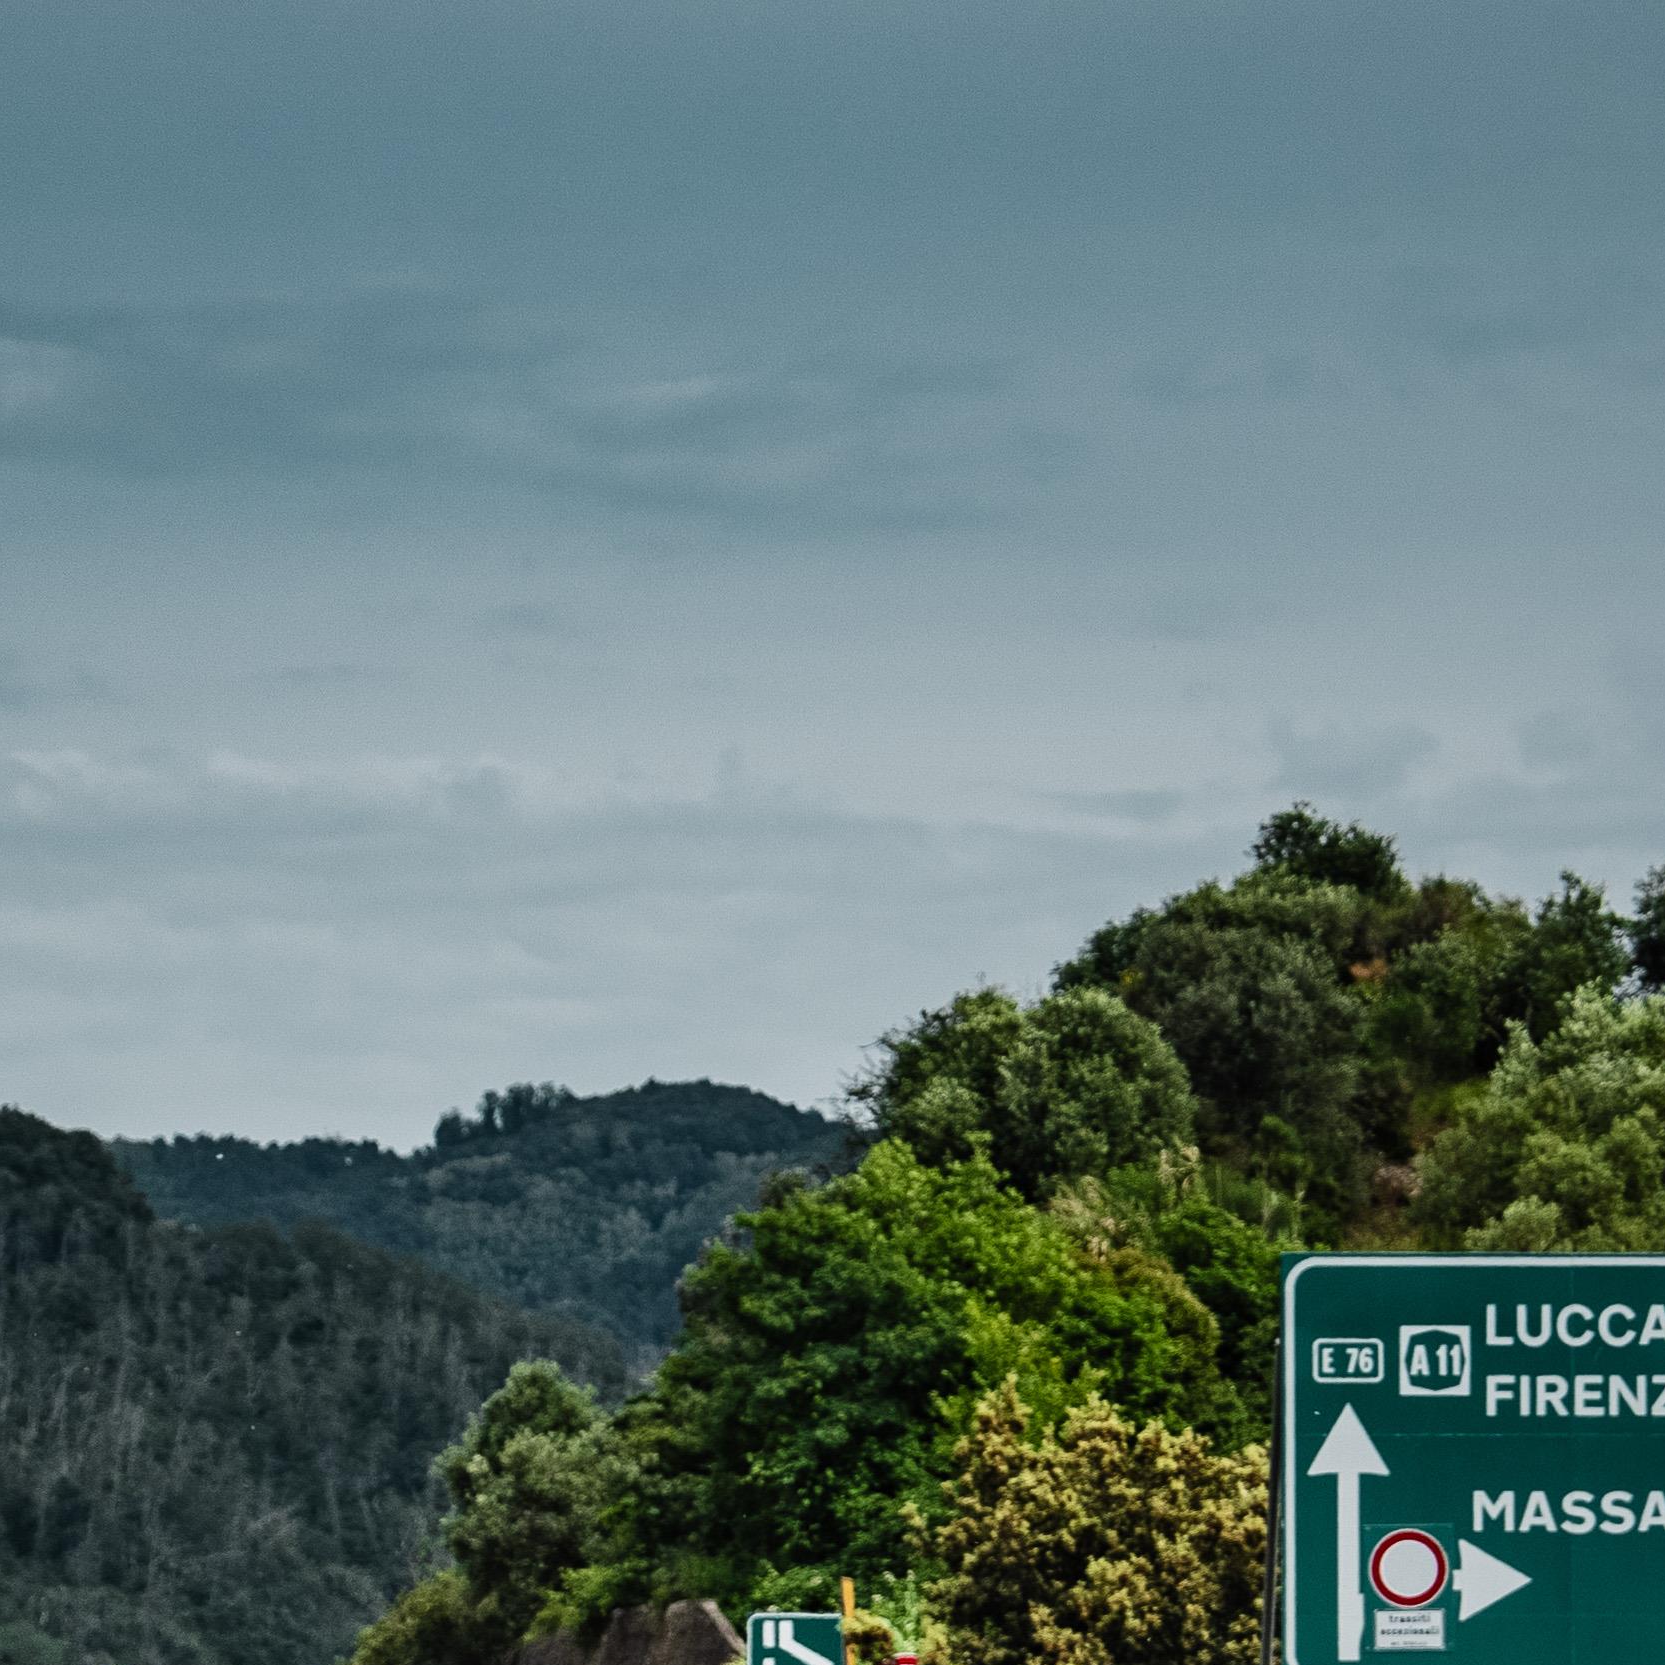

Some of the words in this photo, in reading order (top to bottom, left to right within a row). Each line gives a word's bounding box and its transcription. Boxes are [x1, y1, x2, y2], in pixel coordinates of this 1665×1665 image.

[1321, 1347, 1335, 1374] E
[1345, 1347, 1374, 1374] 76
[1410, 1344, 1431, 1376] A
[1436, 1344, 1461, 1376] 11
